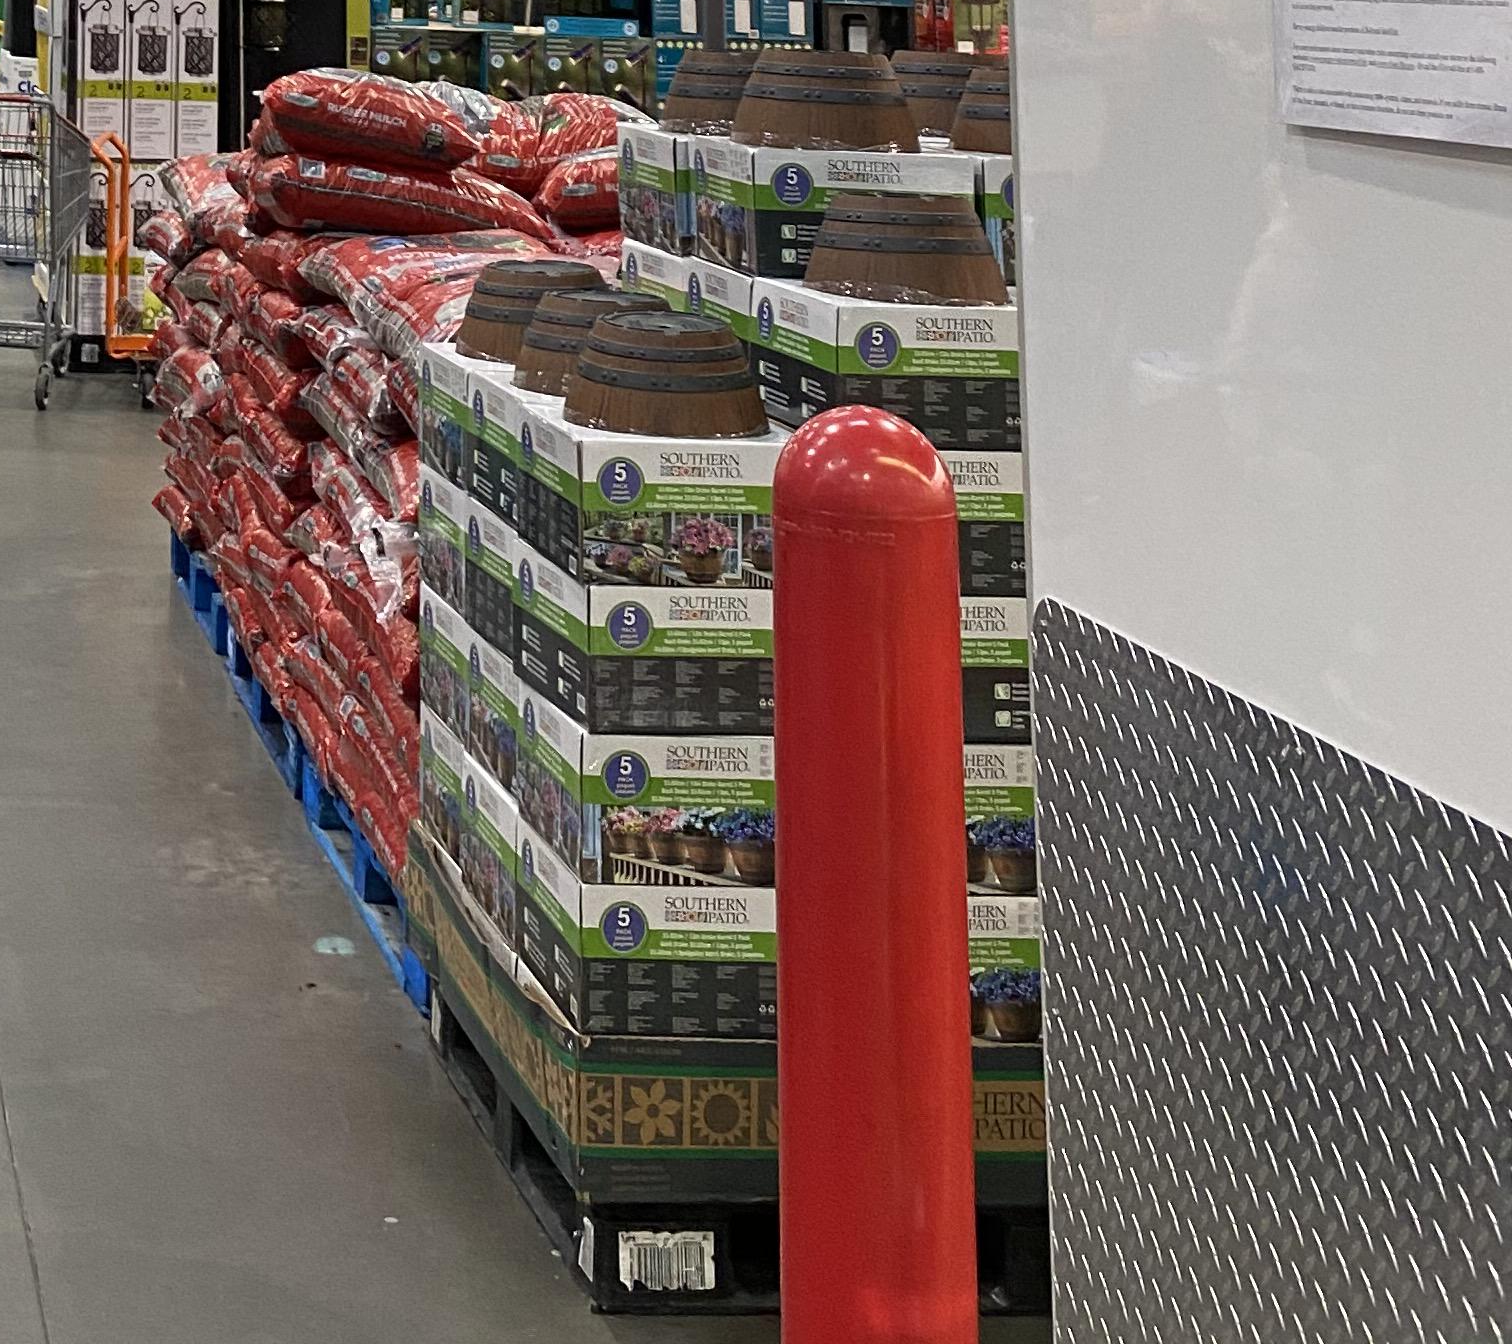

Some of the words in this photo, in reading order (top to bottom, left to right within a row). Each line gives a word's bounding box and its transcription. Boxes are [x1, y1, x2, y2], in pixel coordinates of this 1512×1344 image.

[827, 159, 901, 174] SOUTHERN
[787, 168, 798, 184] 5
[866, 173, 902, 185] PATIO
[916, 316, 994, 331] SOUTHERN
[871, 328, 884, 345] 5
[956, 330, 994, 343] PATIO
[660, 452, 740, 466] SOUTHERN
[614, 463, 627, 482] 5
[703, 466, 740, 479] PATIO
[948, 461, 999, 474] THERN
[963, 474, 999, 486] PATIO
[669, 596, 748, 609] SOUTHERN
[623, 607, 636, 626] 5
[709, 609, 748, 622] PATIO
[960, 606, 1006, 619] THERN
[968, 619, 1006, 632] PATIO
[666, 745, 749, 760] SOUTHERN
[619, 756, 632, 775] 5
[710, 759, 748, 772] PATIO
[964, 754, 1005, 767] HERN
[969, 767, 1005, 780] PATIO
[664, 896, 747, 911] SOUTHERN
[617, 907, 631, 927] 5
[708, 912, 747, 924] PATIO
[969, 918, 1007, 931] PATIO
[974, 1119, 1045, 1141] PATIO
